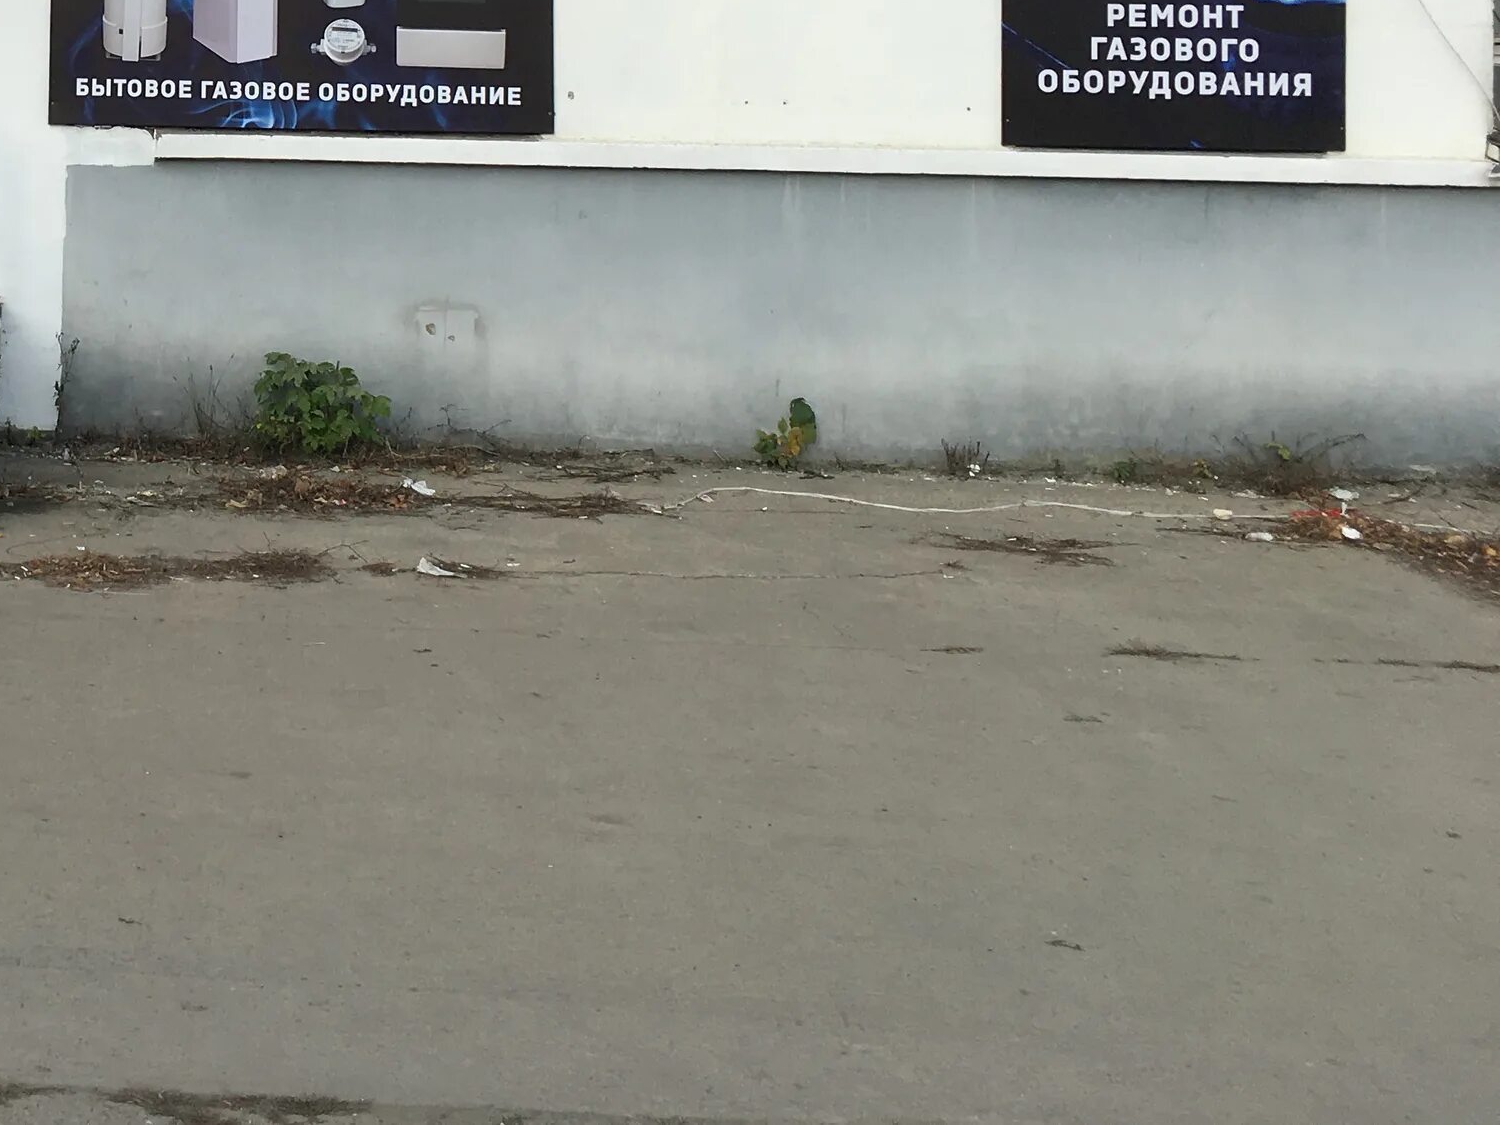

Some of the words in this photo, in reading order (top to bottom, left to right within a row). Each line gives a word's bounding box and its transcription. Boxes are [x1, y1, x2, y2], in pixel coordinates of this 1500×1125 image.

[1107, 3, 1245, 29] РЕМОНТ
[1091, 36, 1260, 63] ГАЗОВОГО
[76, 77, 192, 99] БЫТОВОЕ
[201, 80, 310, 101] ГАЗОВОЕ
[318, 82, 522, 107] ОБОРУДОВАНИЕ
[1038, 68, 1312, 100] ОБОРУДОВАНИЯ
